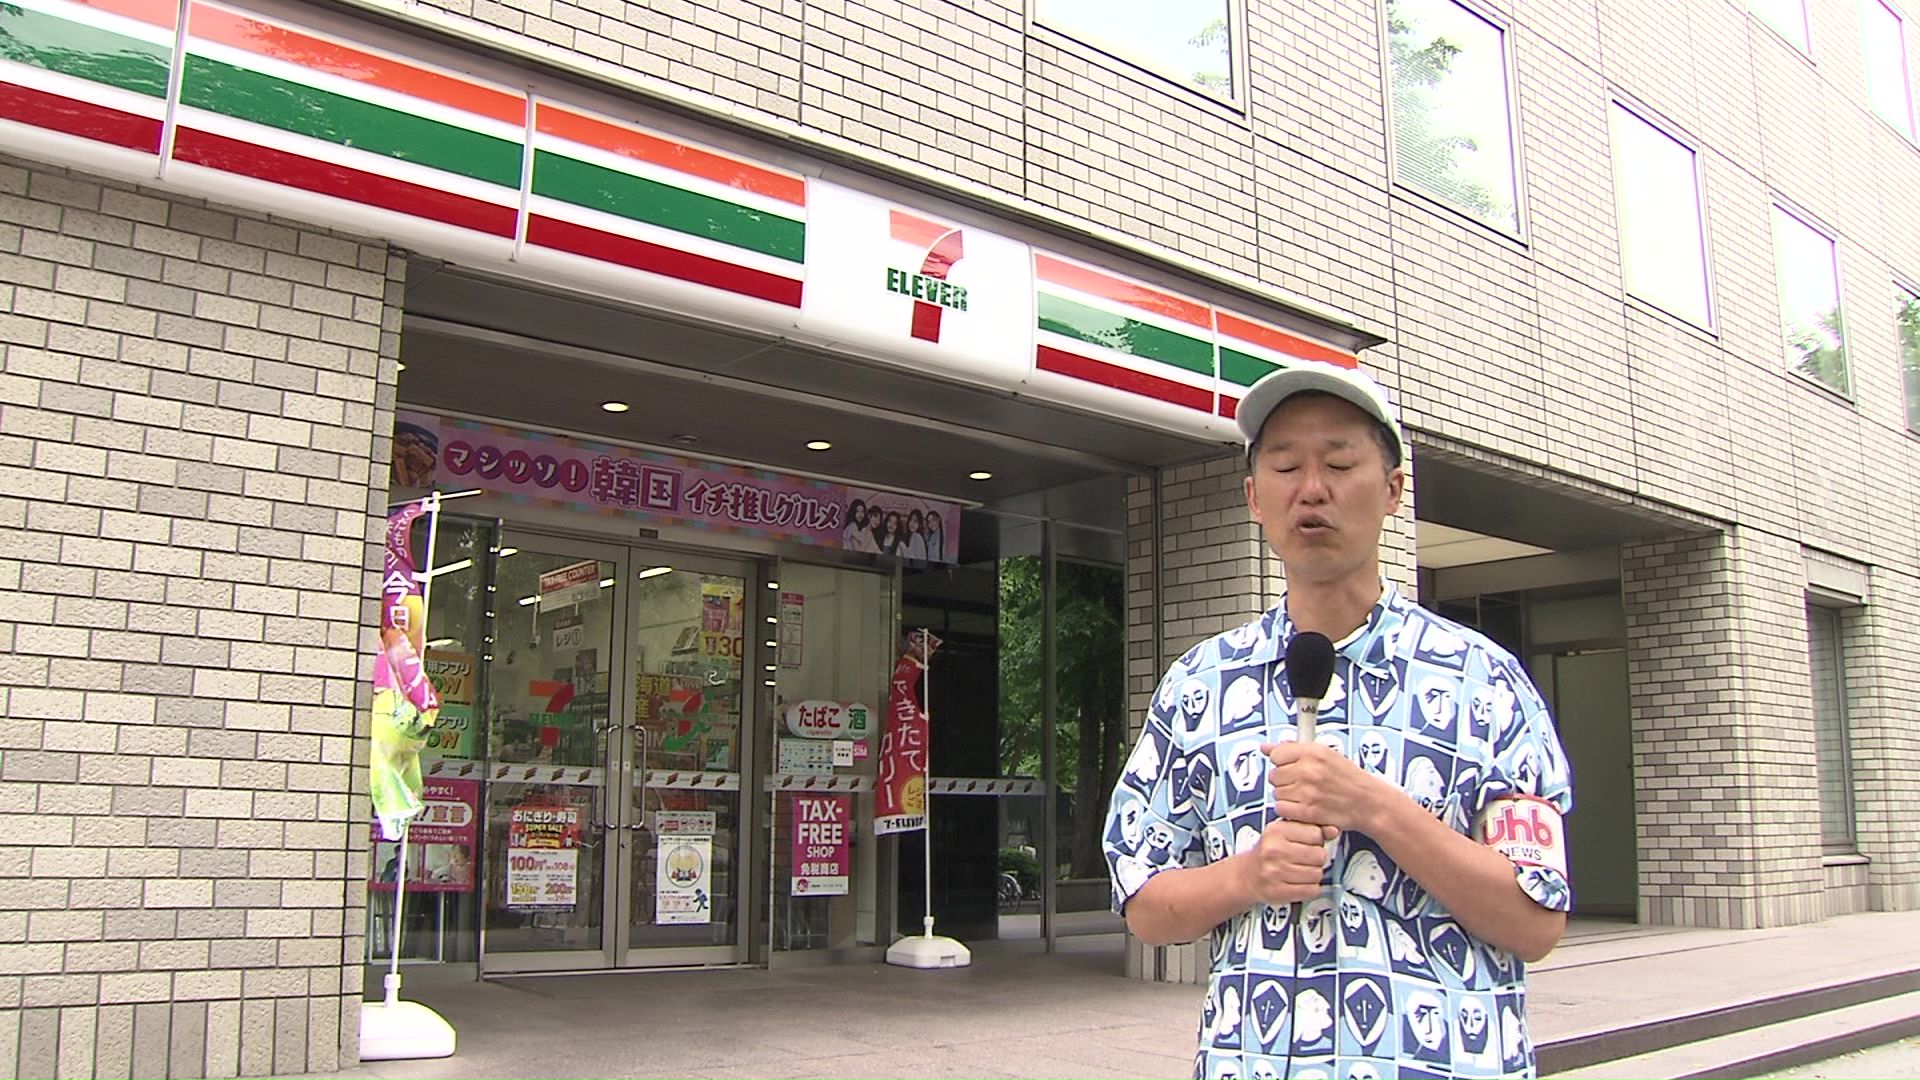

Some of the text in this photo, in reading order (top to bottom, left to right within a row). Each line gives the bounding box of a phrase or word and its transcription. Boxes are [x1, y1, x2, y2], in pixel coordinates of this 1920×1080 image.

[685, 480, 841, 530] イチ推しグルメ
[799, 705, 866, 730] たばこ 酒
[799, 800, 843, 821] TAX-
[798, 823, 843, 845] FREE
[1484, 808, 1553, 846] uhb
[806, 846, 836, 859] SHOP
